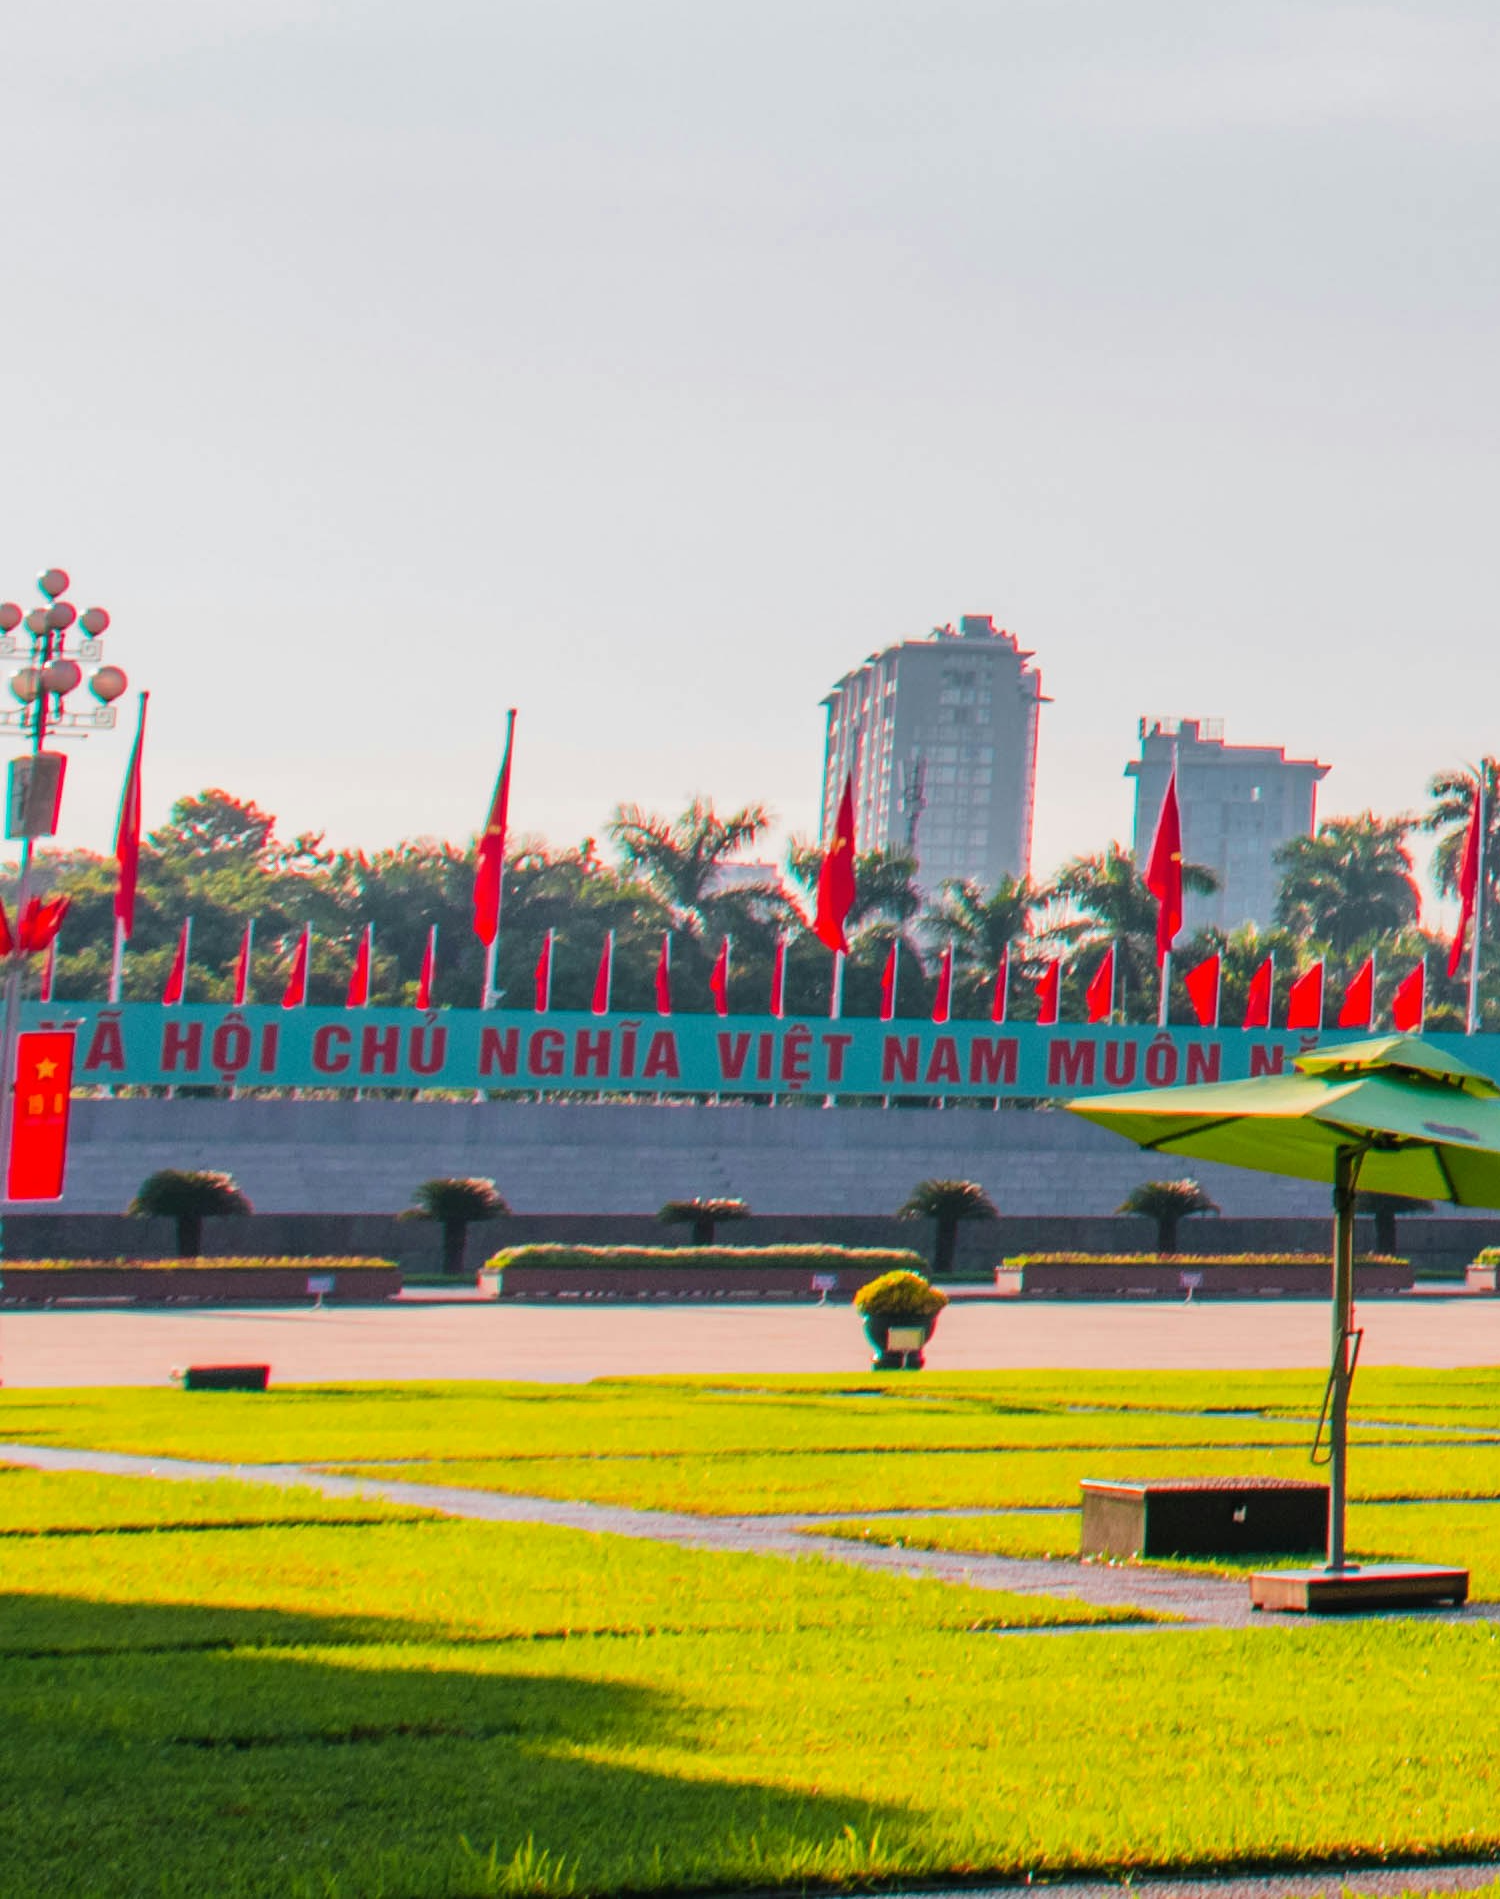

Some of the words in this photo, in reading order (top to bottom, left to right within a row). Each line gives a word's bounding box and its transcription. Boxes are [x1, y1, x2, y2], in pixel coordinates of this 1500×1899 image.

[39, 1010, 126, 1071] Ã
[160, 1013, 278, 1081] HỘI
[312, 1012, 447, 1076] CHỦ
[479, 1020, 680, 1078] NGHĨA
[716, 1024, 852, 1089] VIỆT
[881, 1034, 1019, 1085] NAM
[1048, 1033, 1221, 1086] MUÔN
